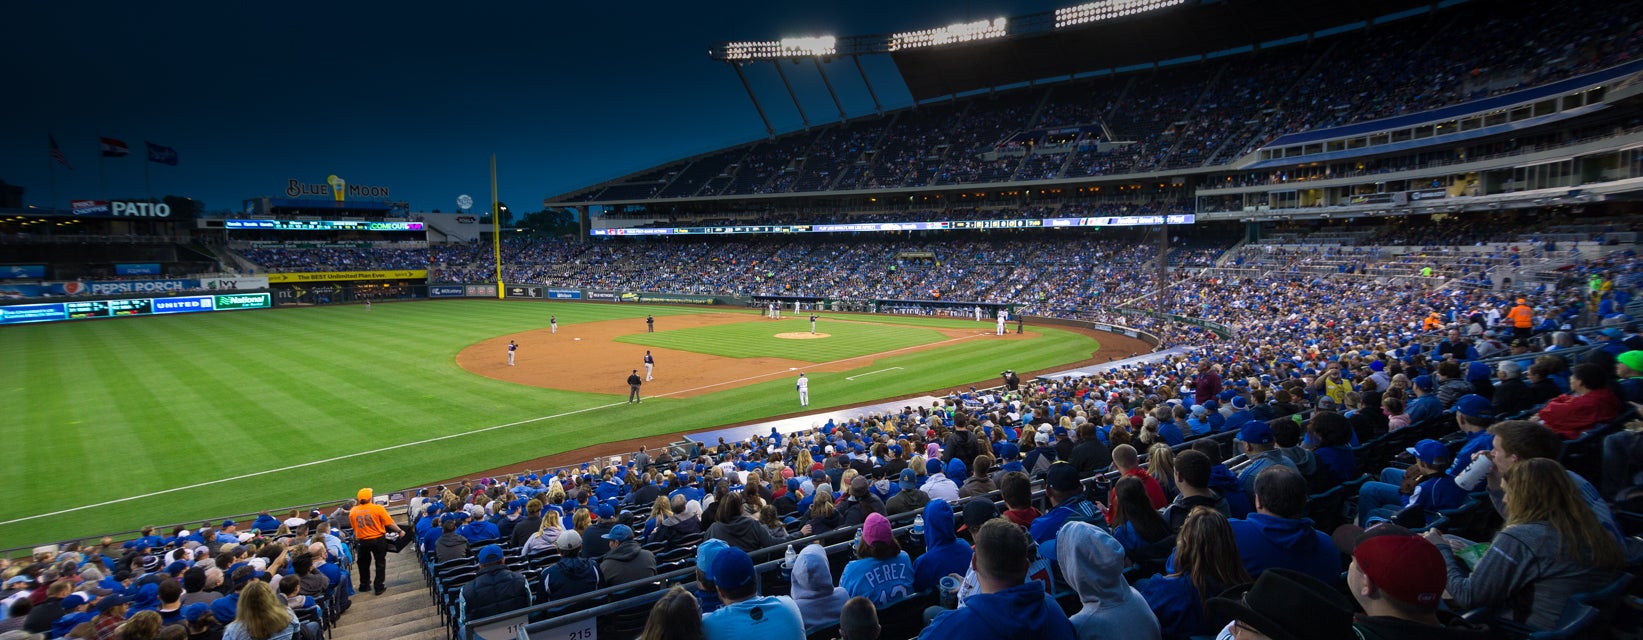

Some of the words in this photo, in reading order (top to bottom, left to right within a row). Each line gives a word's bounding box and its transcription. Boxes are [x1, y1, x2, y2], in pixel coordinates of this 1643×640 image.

[111, 201, 171, 217] PATIO
[92, 283, 132, 295] PEPSI
[135, 280, 183, 292] PORCH
[157, 301, 200, 309] UNITED
[230, 295, 265, 305] National
[865, 563, 906, 588] PEREZ
[569, 627, 592, 640] 215
